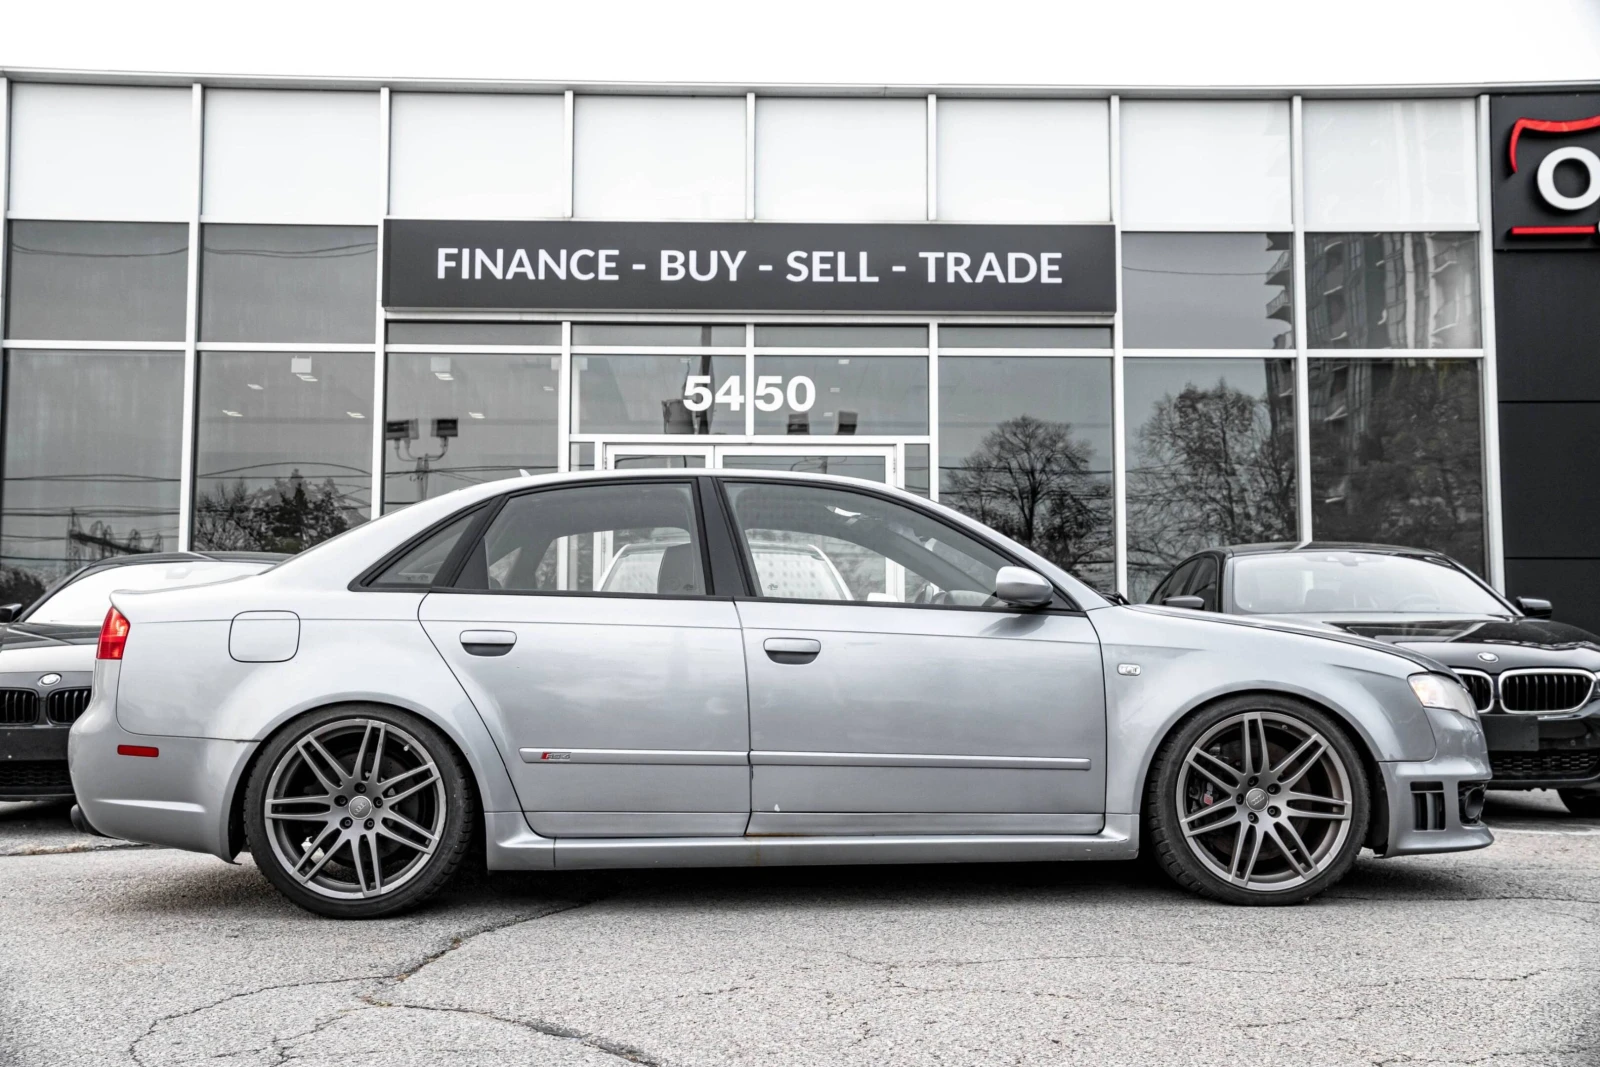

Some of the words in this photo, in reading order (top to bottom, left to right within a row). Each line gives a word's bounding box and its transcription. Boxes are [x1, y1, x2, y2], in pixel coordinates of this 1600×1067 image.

[437, 247, 620, 282] FINANCE
[660, 249, 747, 283] BUY
[785, 250, 880, 284] SELL
[918, 251, 1063, 285] TRADE
[683, 375, 816, 413] 5450
